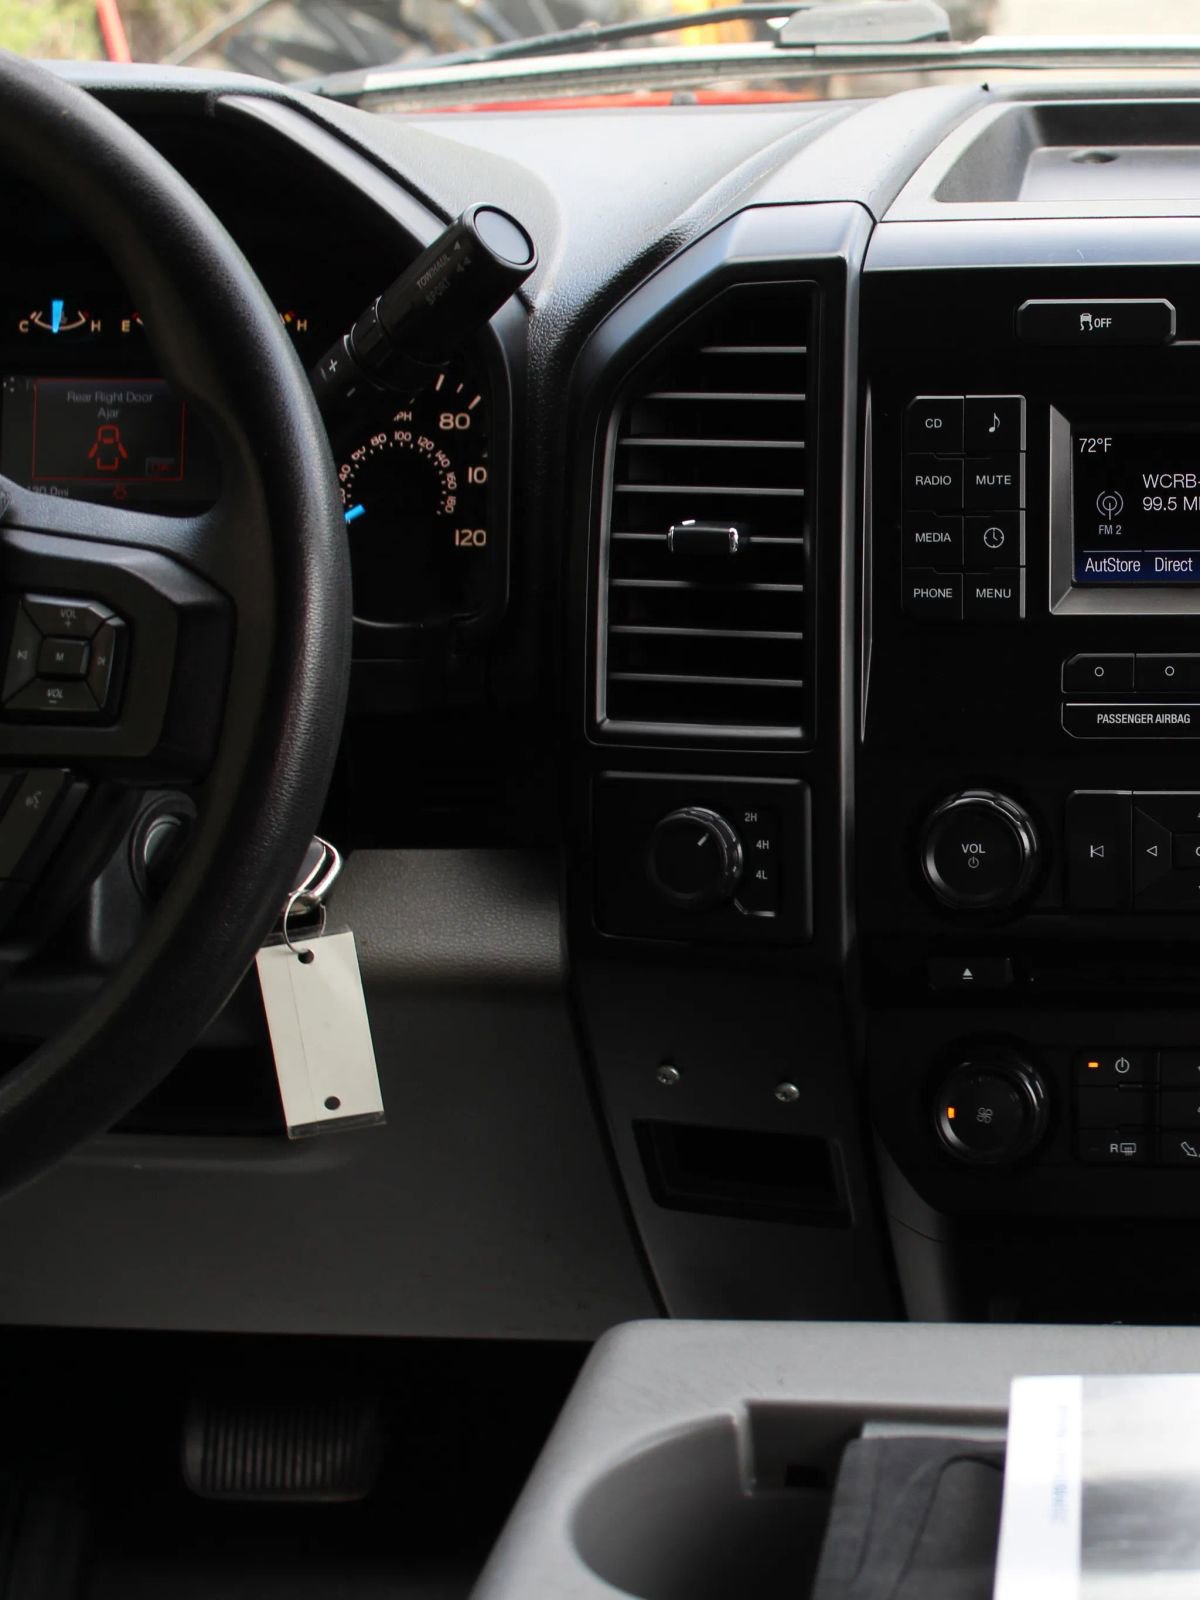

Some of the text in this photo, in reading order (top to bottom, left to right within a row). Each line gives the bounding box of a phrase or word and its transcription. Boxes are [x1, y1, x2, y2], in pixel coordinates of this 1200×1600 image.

[18, 319, 29, 333] C
[90, 319, 101, 332] H
[121, 319, 131, 333] E
[296, 319, 308, 331] H
[1093, 317, 1112, 328] OFF
[67, 390, 153, 405] Rear Right Door
[97, 406, 120, 420] Ajar
[438, 412, 471, 430] 80
[924, 418, 943, 429] CD
[394, 430, 412, 444] 100
[417, 434, 435, 451] 120
[1079, 437, 1113, 453] 72°F
[915, 475, 952, 486] RADIO
[975, 474, 1012, 485] MUTE
[1142, 496, 1178, 511] 99.5
[1098, 524, 1122, 535] FM 2
[454, 528, 487, 547] 120
[915, 532, 952, 543] MEDIA
[1084, 557, 1141, 573] AutStore
[1154, 557, 1193, 572] Direct
[913, 587, 953, 599] PHONE
[975, 588, 1012, 599] MENU
[1096, 713, 1154, 724] PASSENGER
[1154, 713, 1191, 724] AIRBAG
[744, 812, 758, 823] 2H
[755, 839, 770, 850] 4H
[961, 843, 986, 854] VOL
[755, 869, 768, 880] 4L
